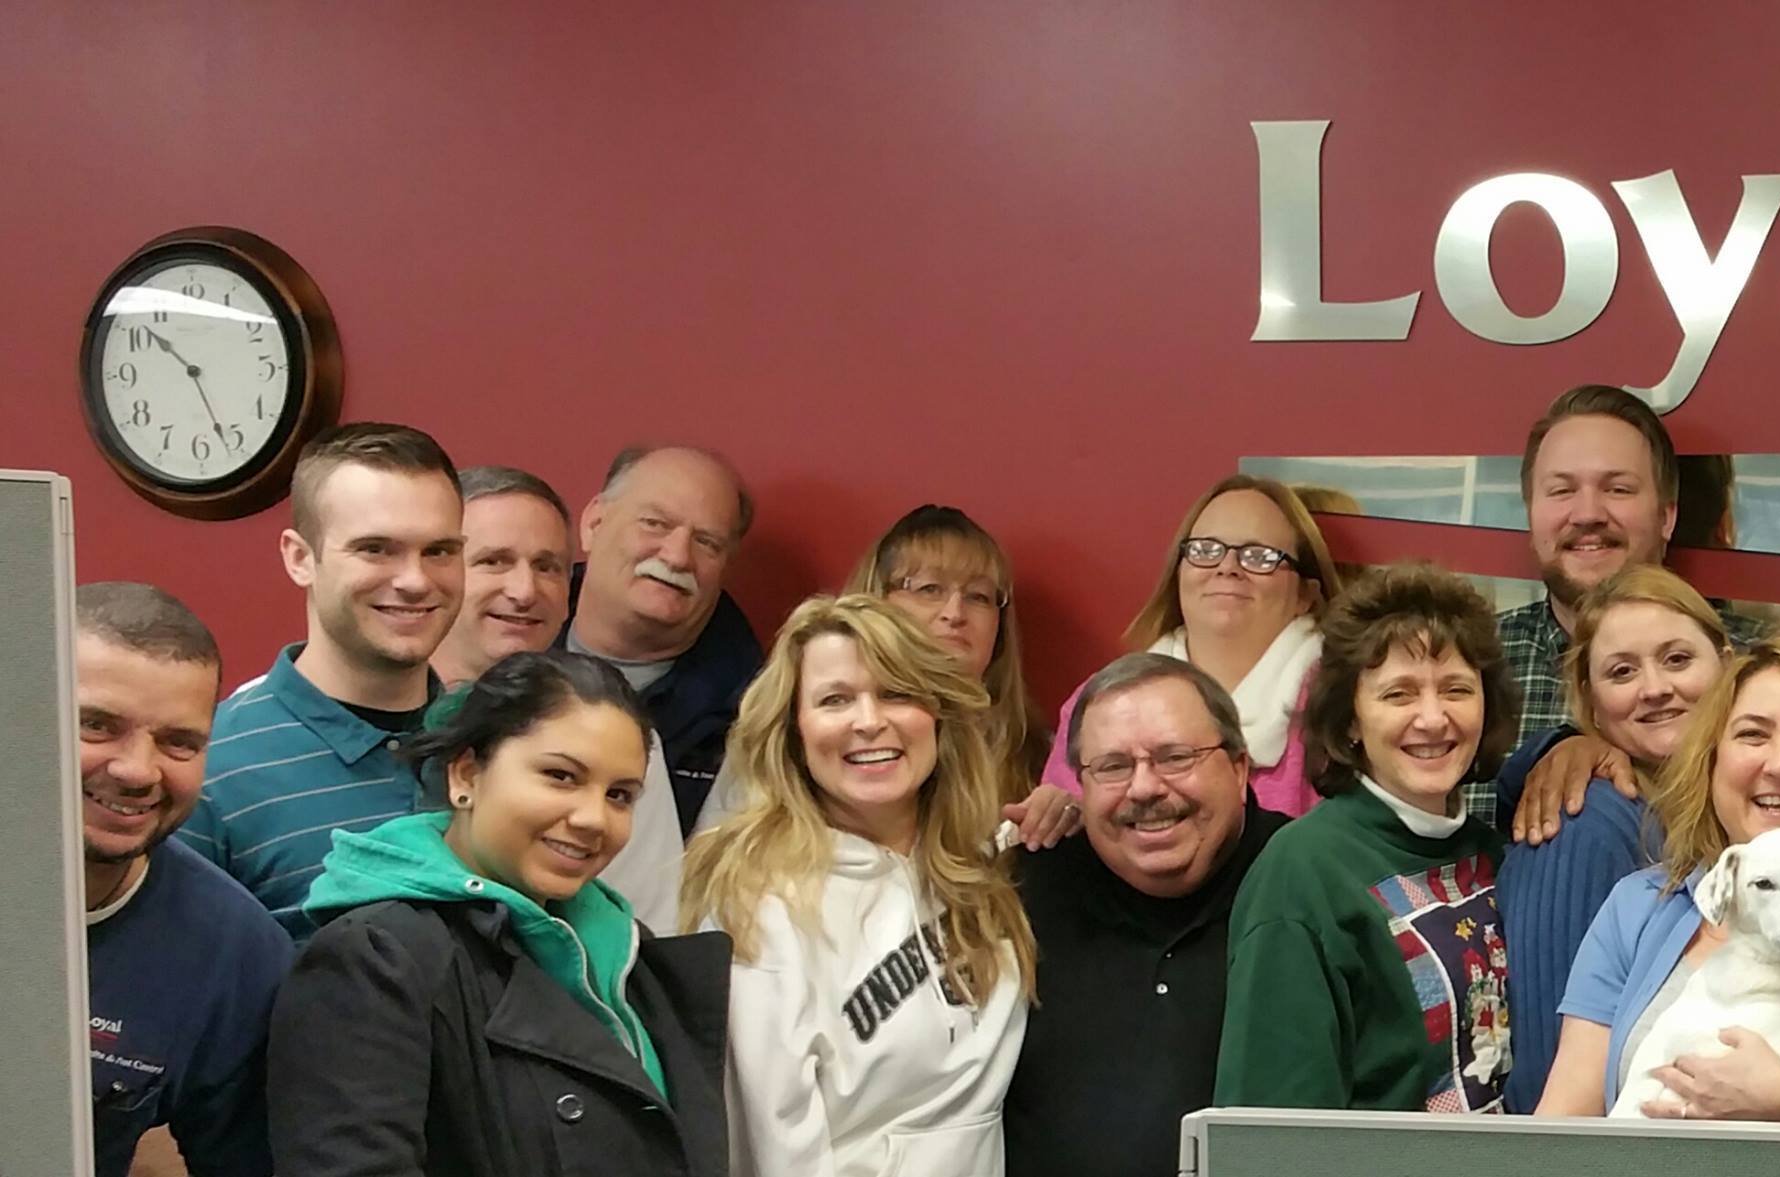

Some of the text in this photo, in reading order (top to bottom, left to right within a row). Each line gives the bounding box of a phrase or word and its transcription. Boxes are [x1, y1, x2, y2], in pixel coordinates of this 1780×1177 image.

[128, 325, 153, 352] 10
[119, 363, 137, 389] 9
[132, 400, 151, 427] 8
[160, 424, 174, 450] 7
[191, 433, 210, 461] 6
[227, 424, 244, 451] 5
[89, 1016, 122, 1033] oyal
